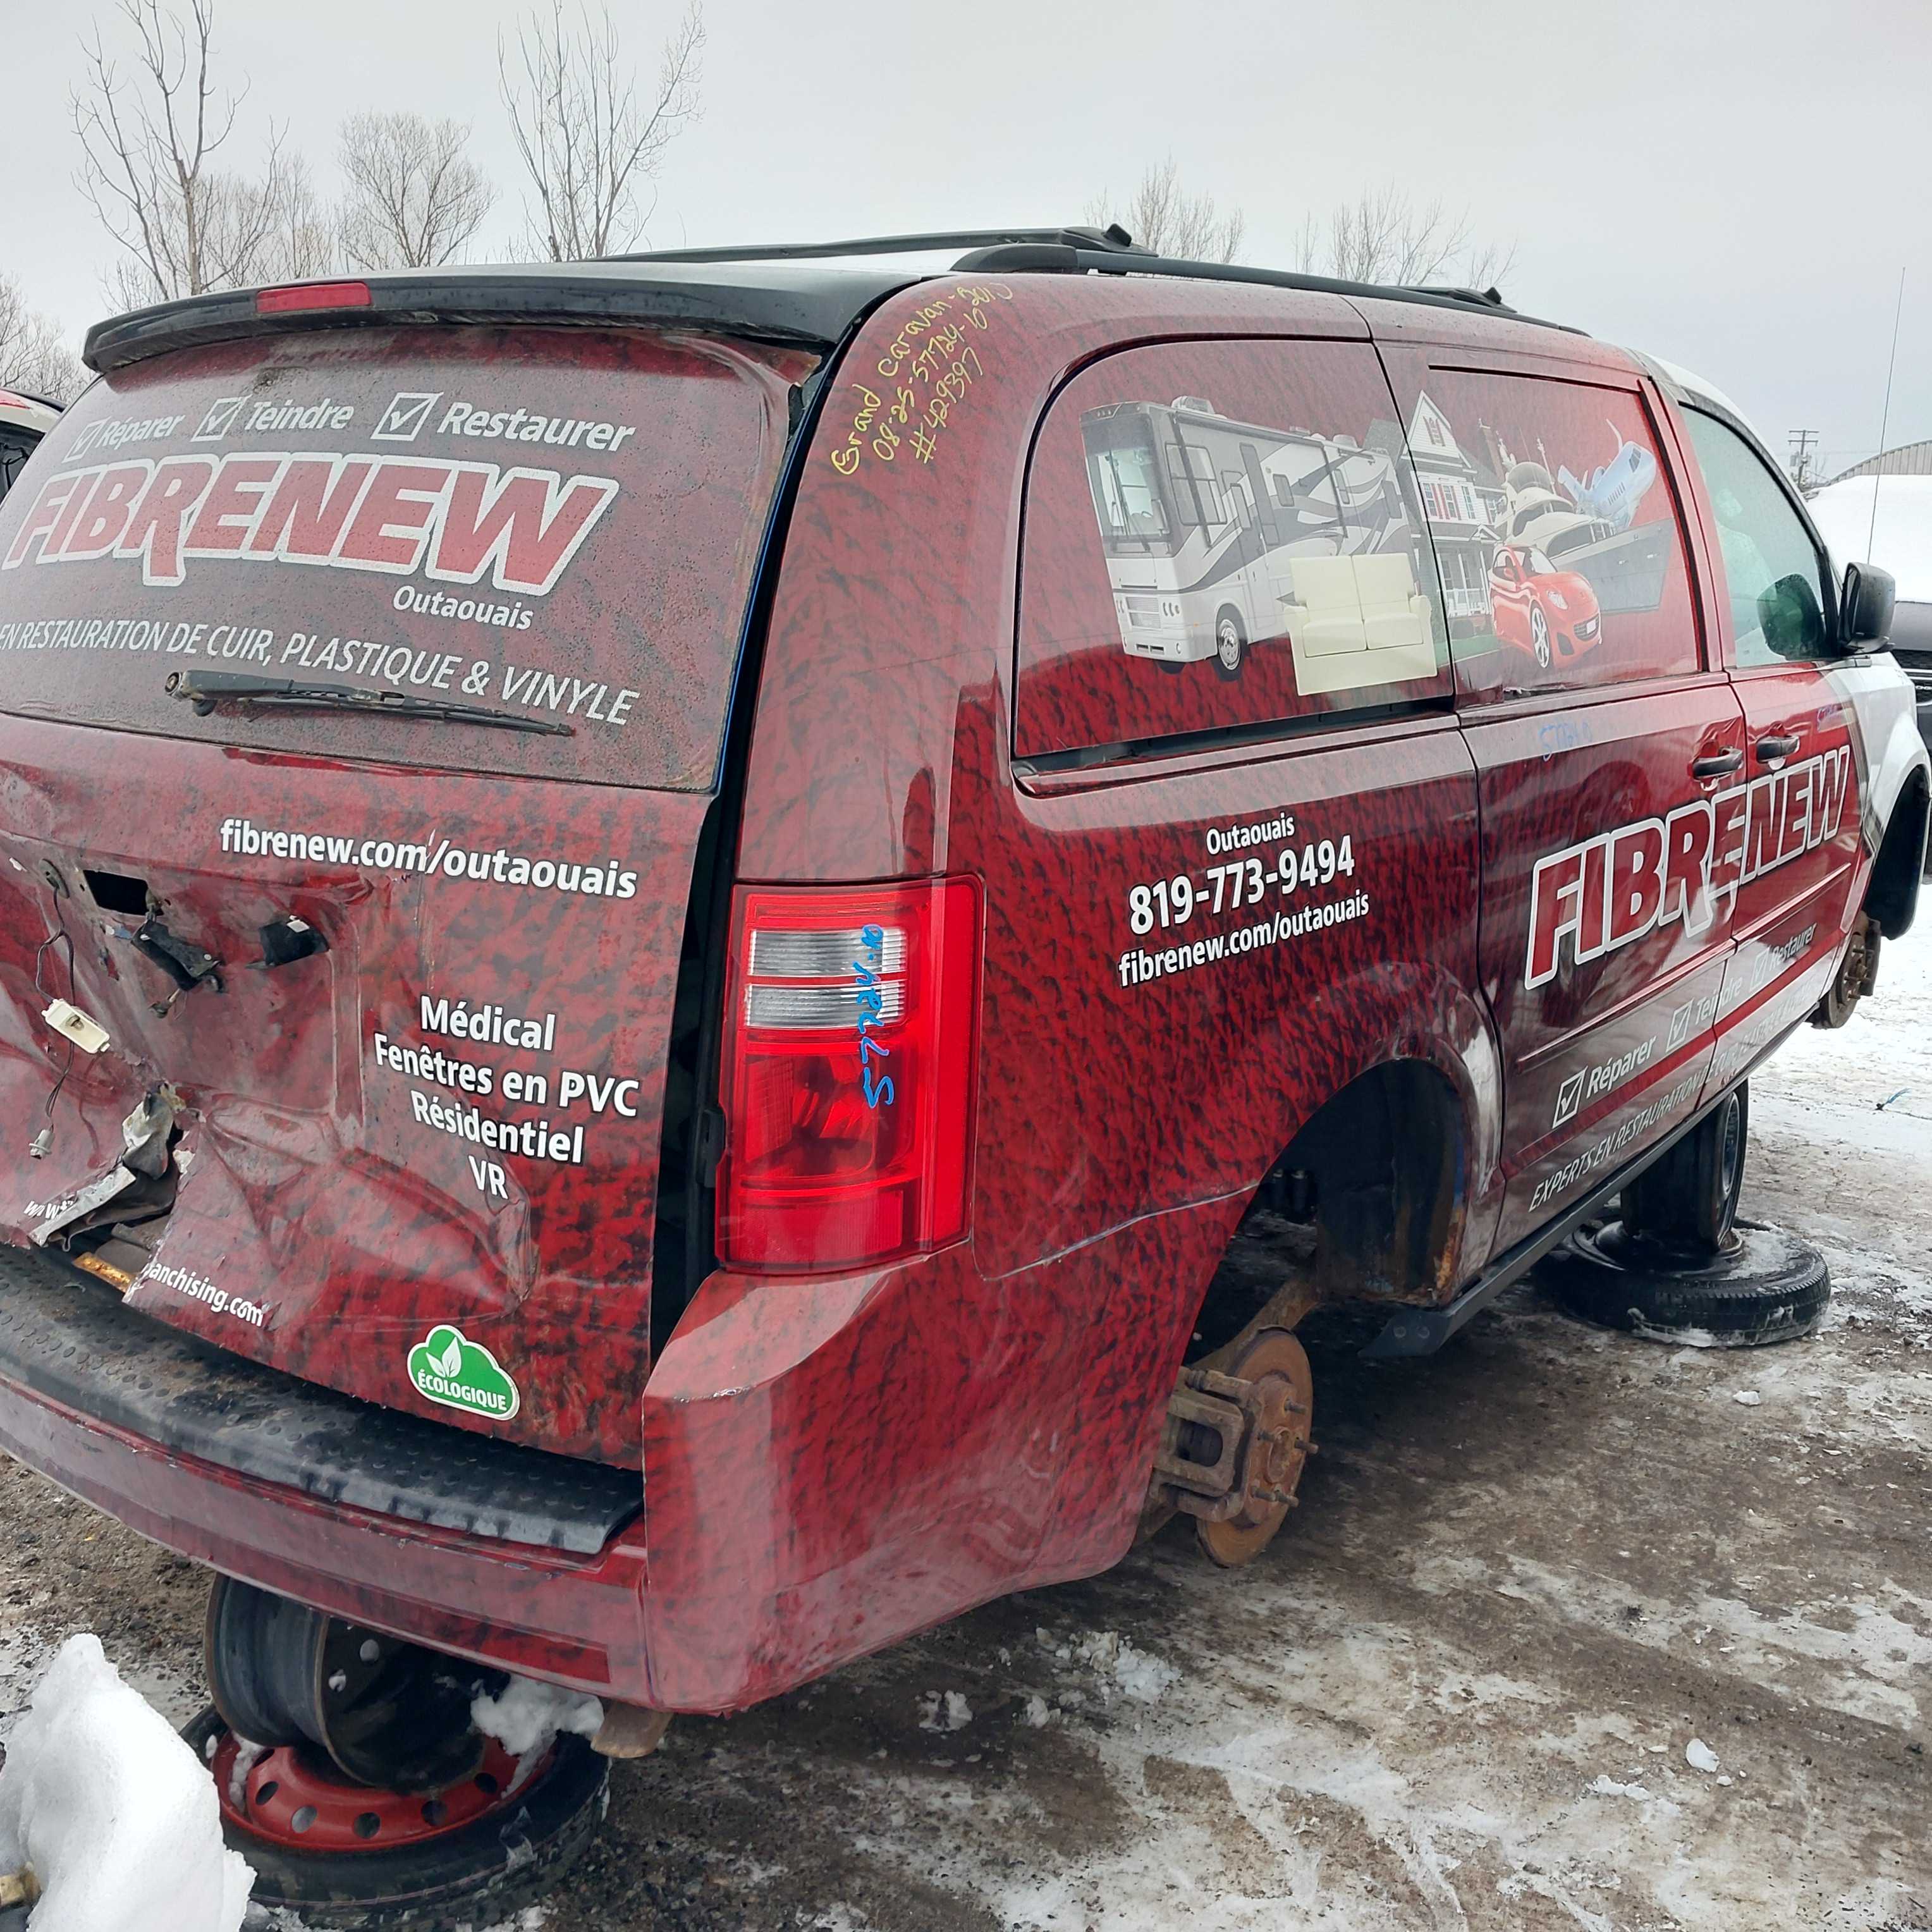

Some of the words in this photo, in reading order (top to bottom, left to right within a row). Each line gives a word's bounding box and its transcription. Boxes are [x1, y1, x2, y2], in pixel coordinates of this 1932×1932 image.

[95, 414, 186, 451] Réparer
[245, 398, 354, 431] Teindre
[437, 402, 635, 452] Restaurer
[2, 451, 620, 596] FIBRENEW
[392, 585, 534, 630] Outaouais
[0, 623, 22, 650] EN
[16, 620, 169, 651] RESTAURATION
[166, 623, 208, 654] DE
[207, 625, 274, 666] CUIR,
[279, 633, 465, 690] PLASTIQUE
[463, 660, 489, 697] &
[501, 666, 640, 727] VINYLE
[220, 818, 638, 899] fibrenew.com/outaouais
[1207, 812, 1295, 855] Outaouais
[1129, 835, 1355, 934] 819-773-9494
[1525, 745, 1850, 989] FIBRENEW
[1119, 890, 1369, 987] fibrenew.com/outaouais
[1770, 923, 1818, 970] Restaurer
[420, 994, 556, 1051] Médical
[374, 1033, 493, 1094] Fenêtres
[502, 1073, 546, 1104] en
[559, 1071, 639, 1116] PVC
[1587, 1036, 1657, 1099] Réparer
[411, 1090, 584, 1163] Résidentiel
[1529, 1147, 1596, 1212] EXPERTS
[1593, 1135, 1616, 1167] EN
[1613, 1074, 1699, 1152] RESTAURATION
[468, 1155, 508, 1199] VR
[417, 1368, 507, 1411] ÉCOLOGIQUE
